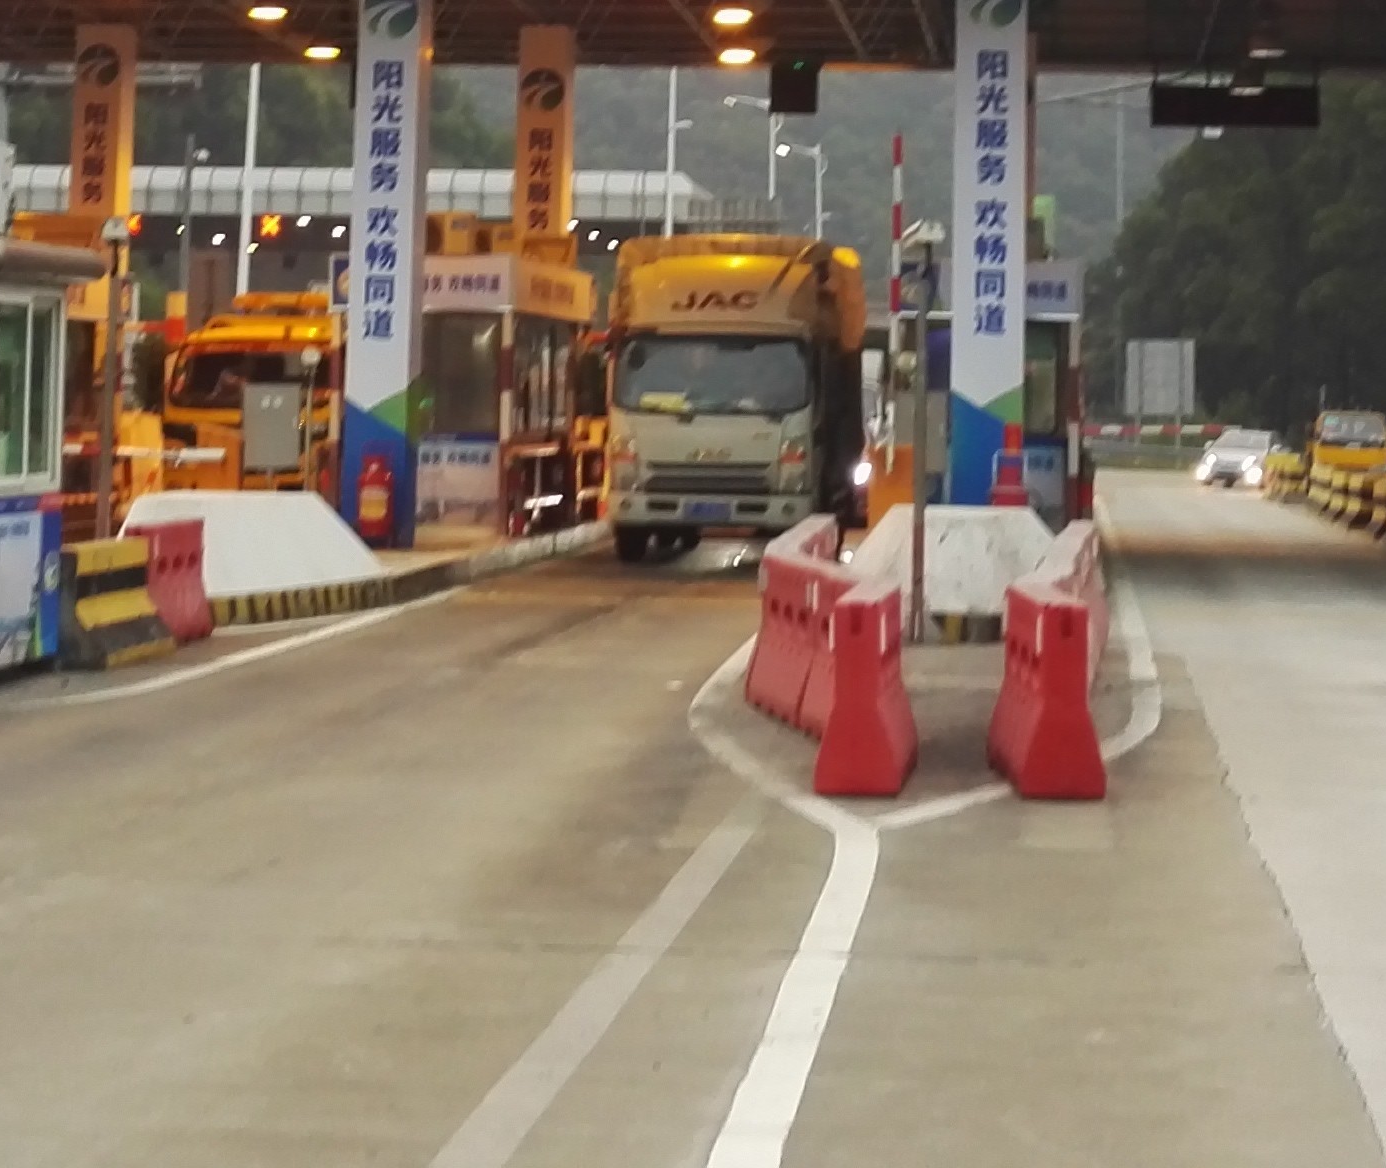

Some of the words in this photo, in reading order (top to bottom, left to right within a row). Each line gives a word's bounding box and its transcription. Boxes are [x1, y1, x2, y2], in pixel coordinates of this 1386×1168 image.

[369, 60, 405, 193] 阳光服务
[974, 49, 1009, 184] 阳光服务
[362, 205, 399, 340] 欢畅同道
[671, 290, 760, 312] JAC
[973, 197, 1008, 336] 欢畅同道
